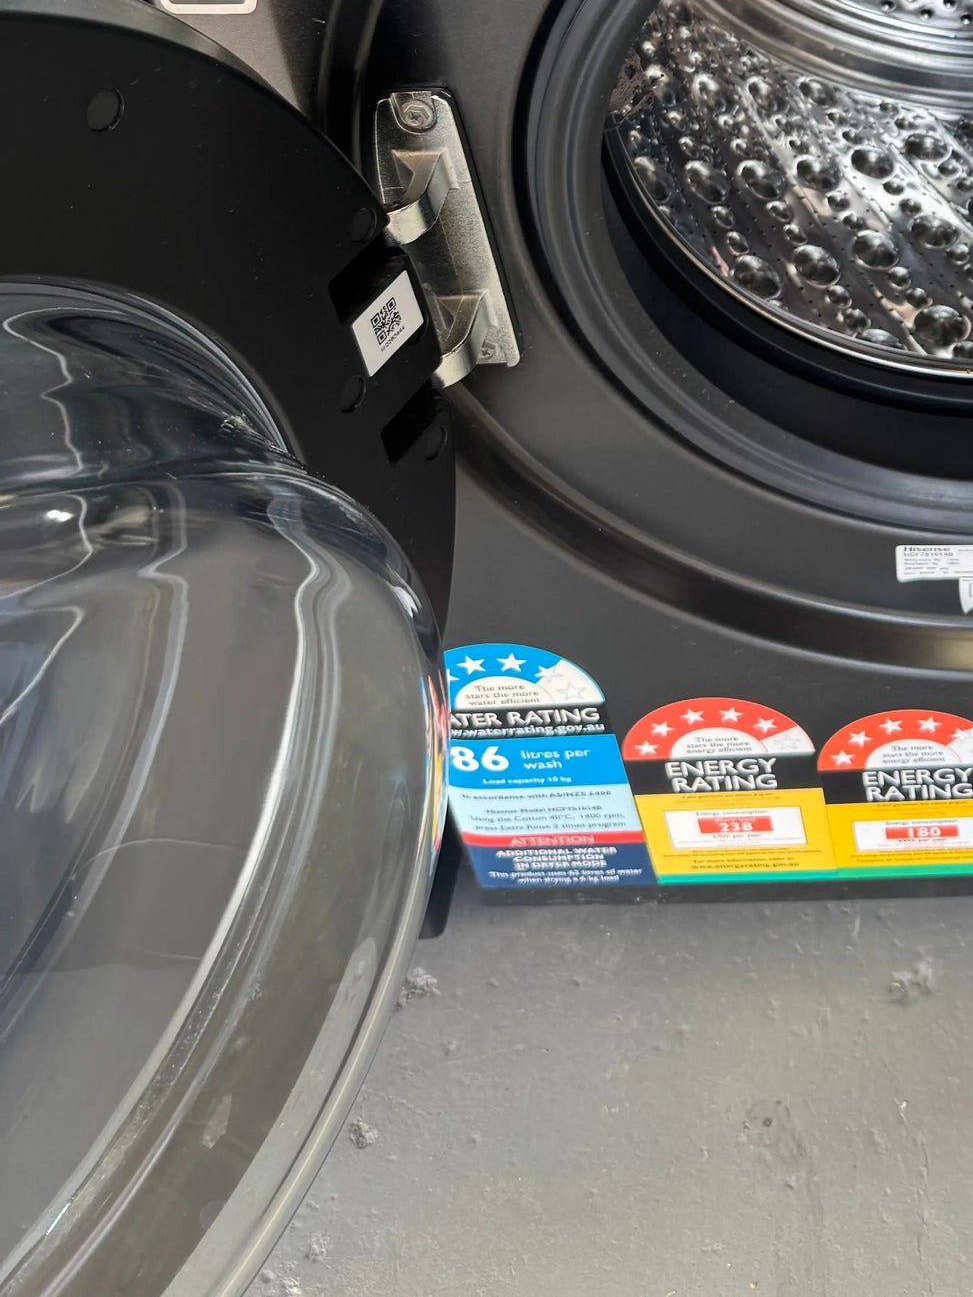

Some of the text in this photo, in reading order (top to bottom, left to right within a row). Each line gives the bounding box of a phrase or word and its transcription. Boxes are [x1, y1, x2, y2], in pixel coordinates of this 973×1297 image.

[500, 697, 541, 705] efficient
[450, 707, 601, 729] ATER RATING
[450, 723, 605, 739] w.waterrating.gov.au
[450, 746, 591, 772] 86 litres per
[523, 761, 563, 770] wash
[665, 757, 777, 778] ENERGY
[671, 773, 778, 793] RATING
[862, 767, 973, 788] ENERGY
[866, 782, 973, 802] RATING
[719, 821, 753, 832] 238
[907, 826, 942, 838] 180
[510, 835, 595, 847] ATTENTION
[496, 846, 618, 859] ADDITIONAL WATER
[513, 853, 605, 863] CONSUMPTION
[571, 859, 607, 868] MODE
